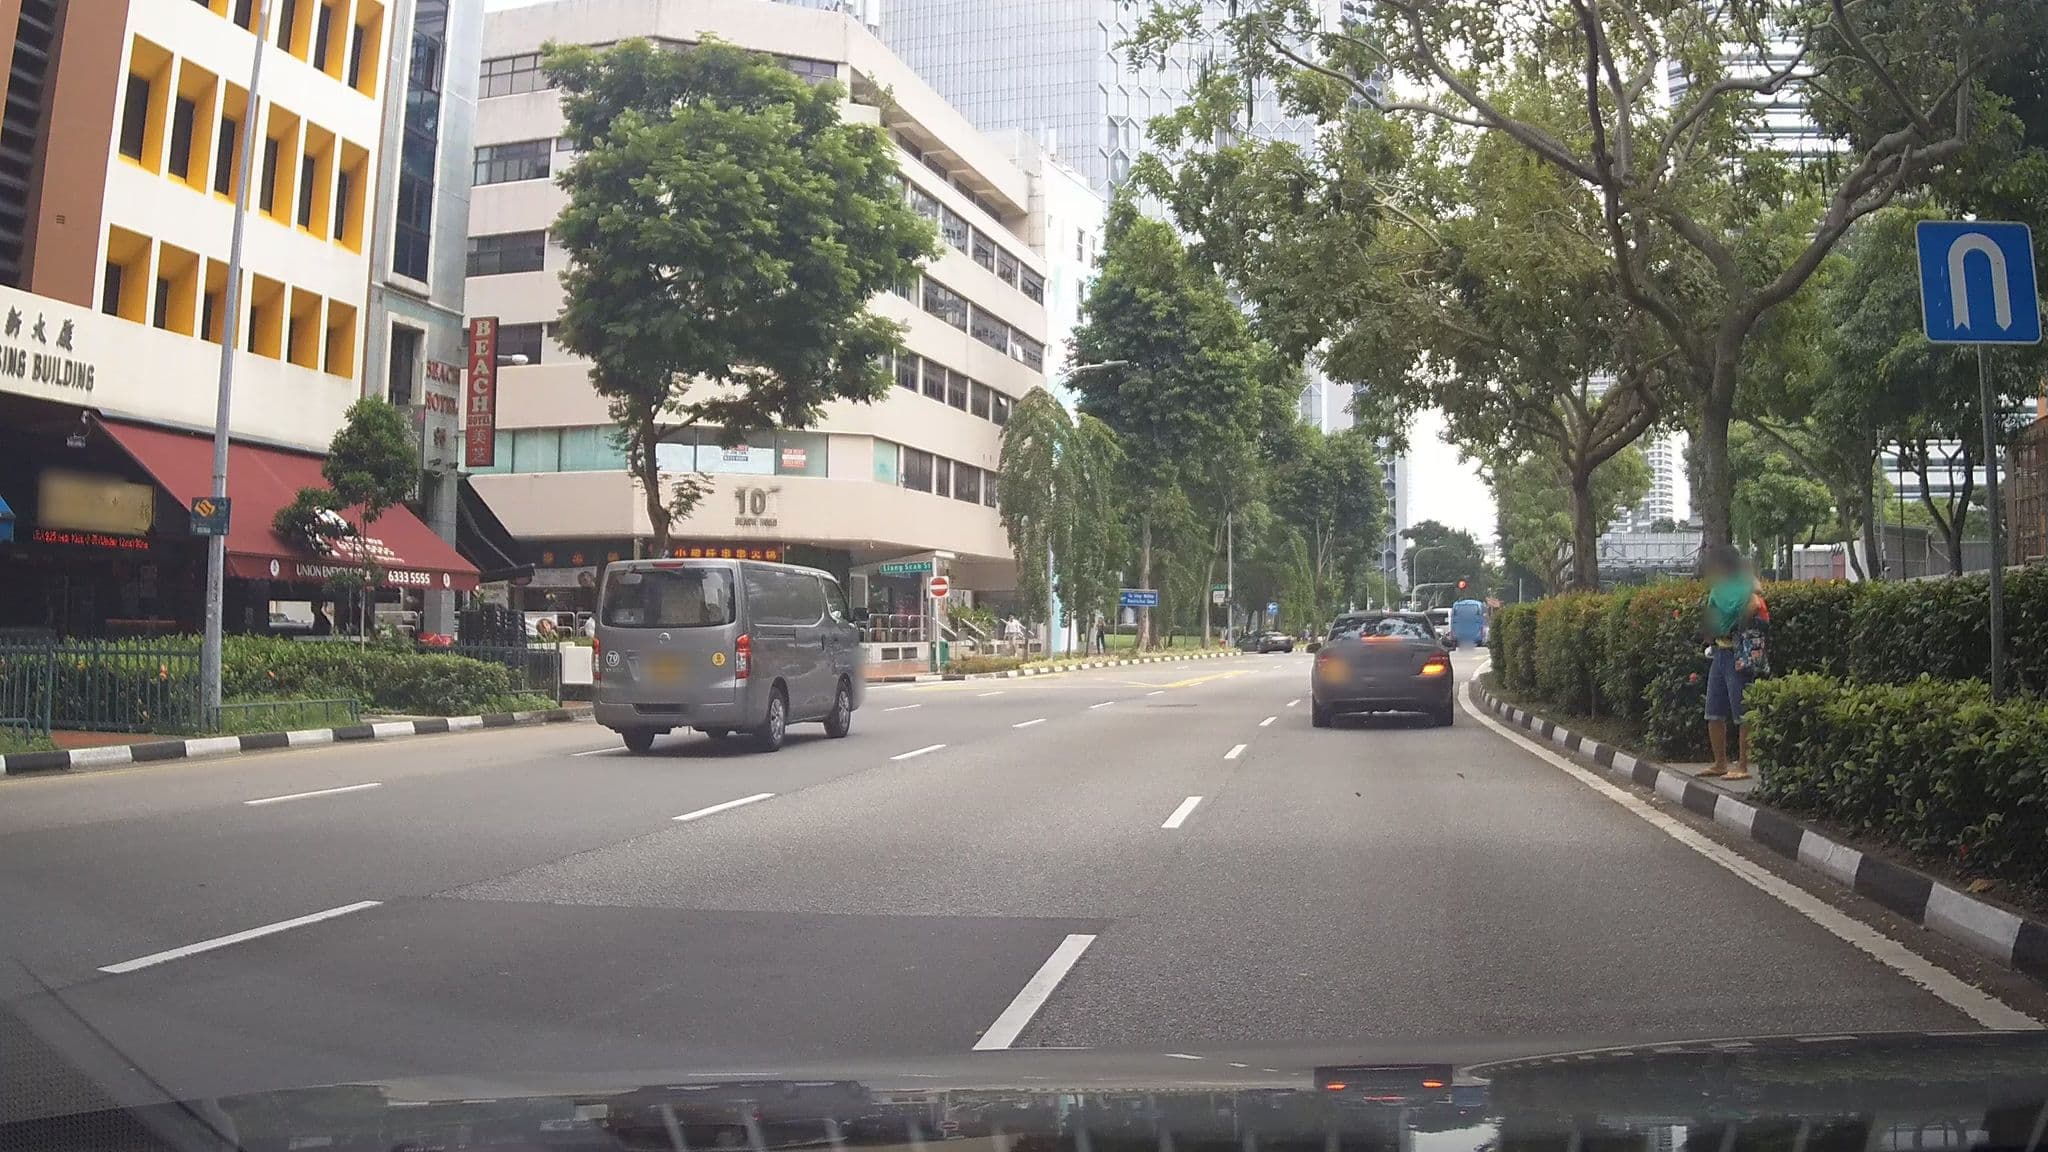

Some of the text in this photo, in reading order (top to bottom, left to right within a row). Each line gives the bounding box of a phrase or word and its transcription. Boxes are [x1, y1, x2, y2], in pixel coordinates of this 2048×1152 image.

[31, 352, 95, 392] BUILDING
[472, 320, 490, 412] BEACH
[734, 487, 767, 515] 10
[296, 564, 321, 576] UNION
[388, 570, 431, 584] 6333 5555
[609, 654, 618, 662] 70
